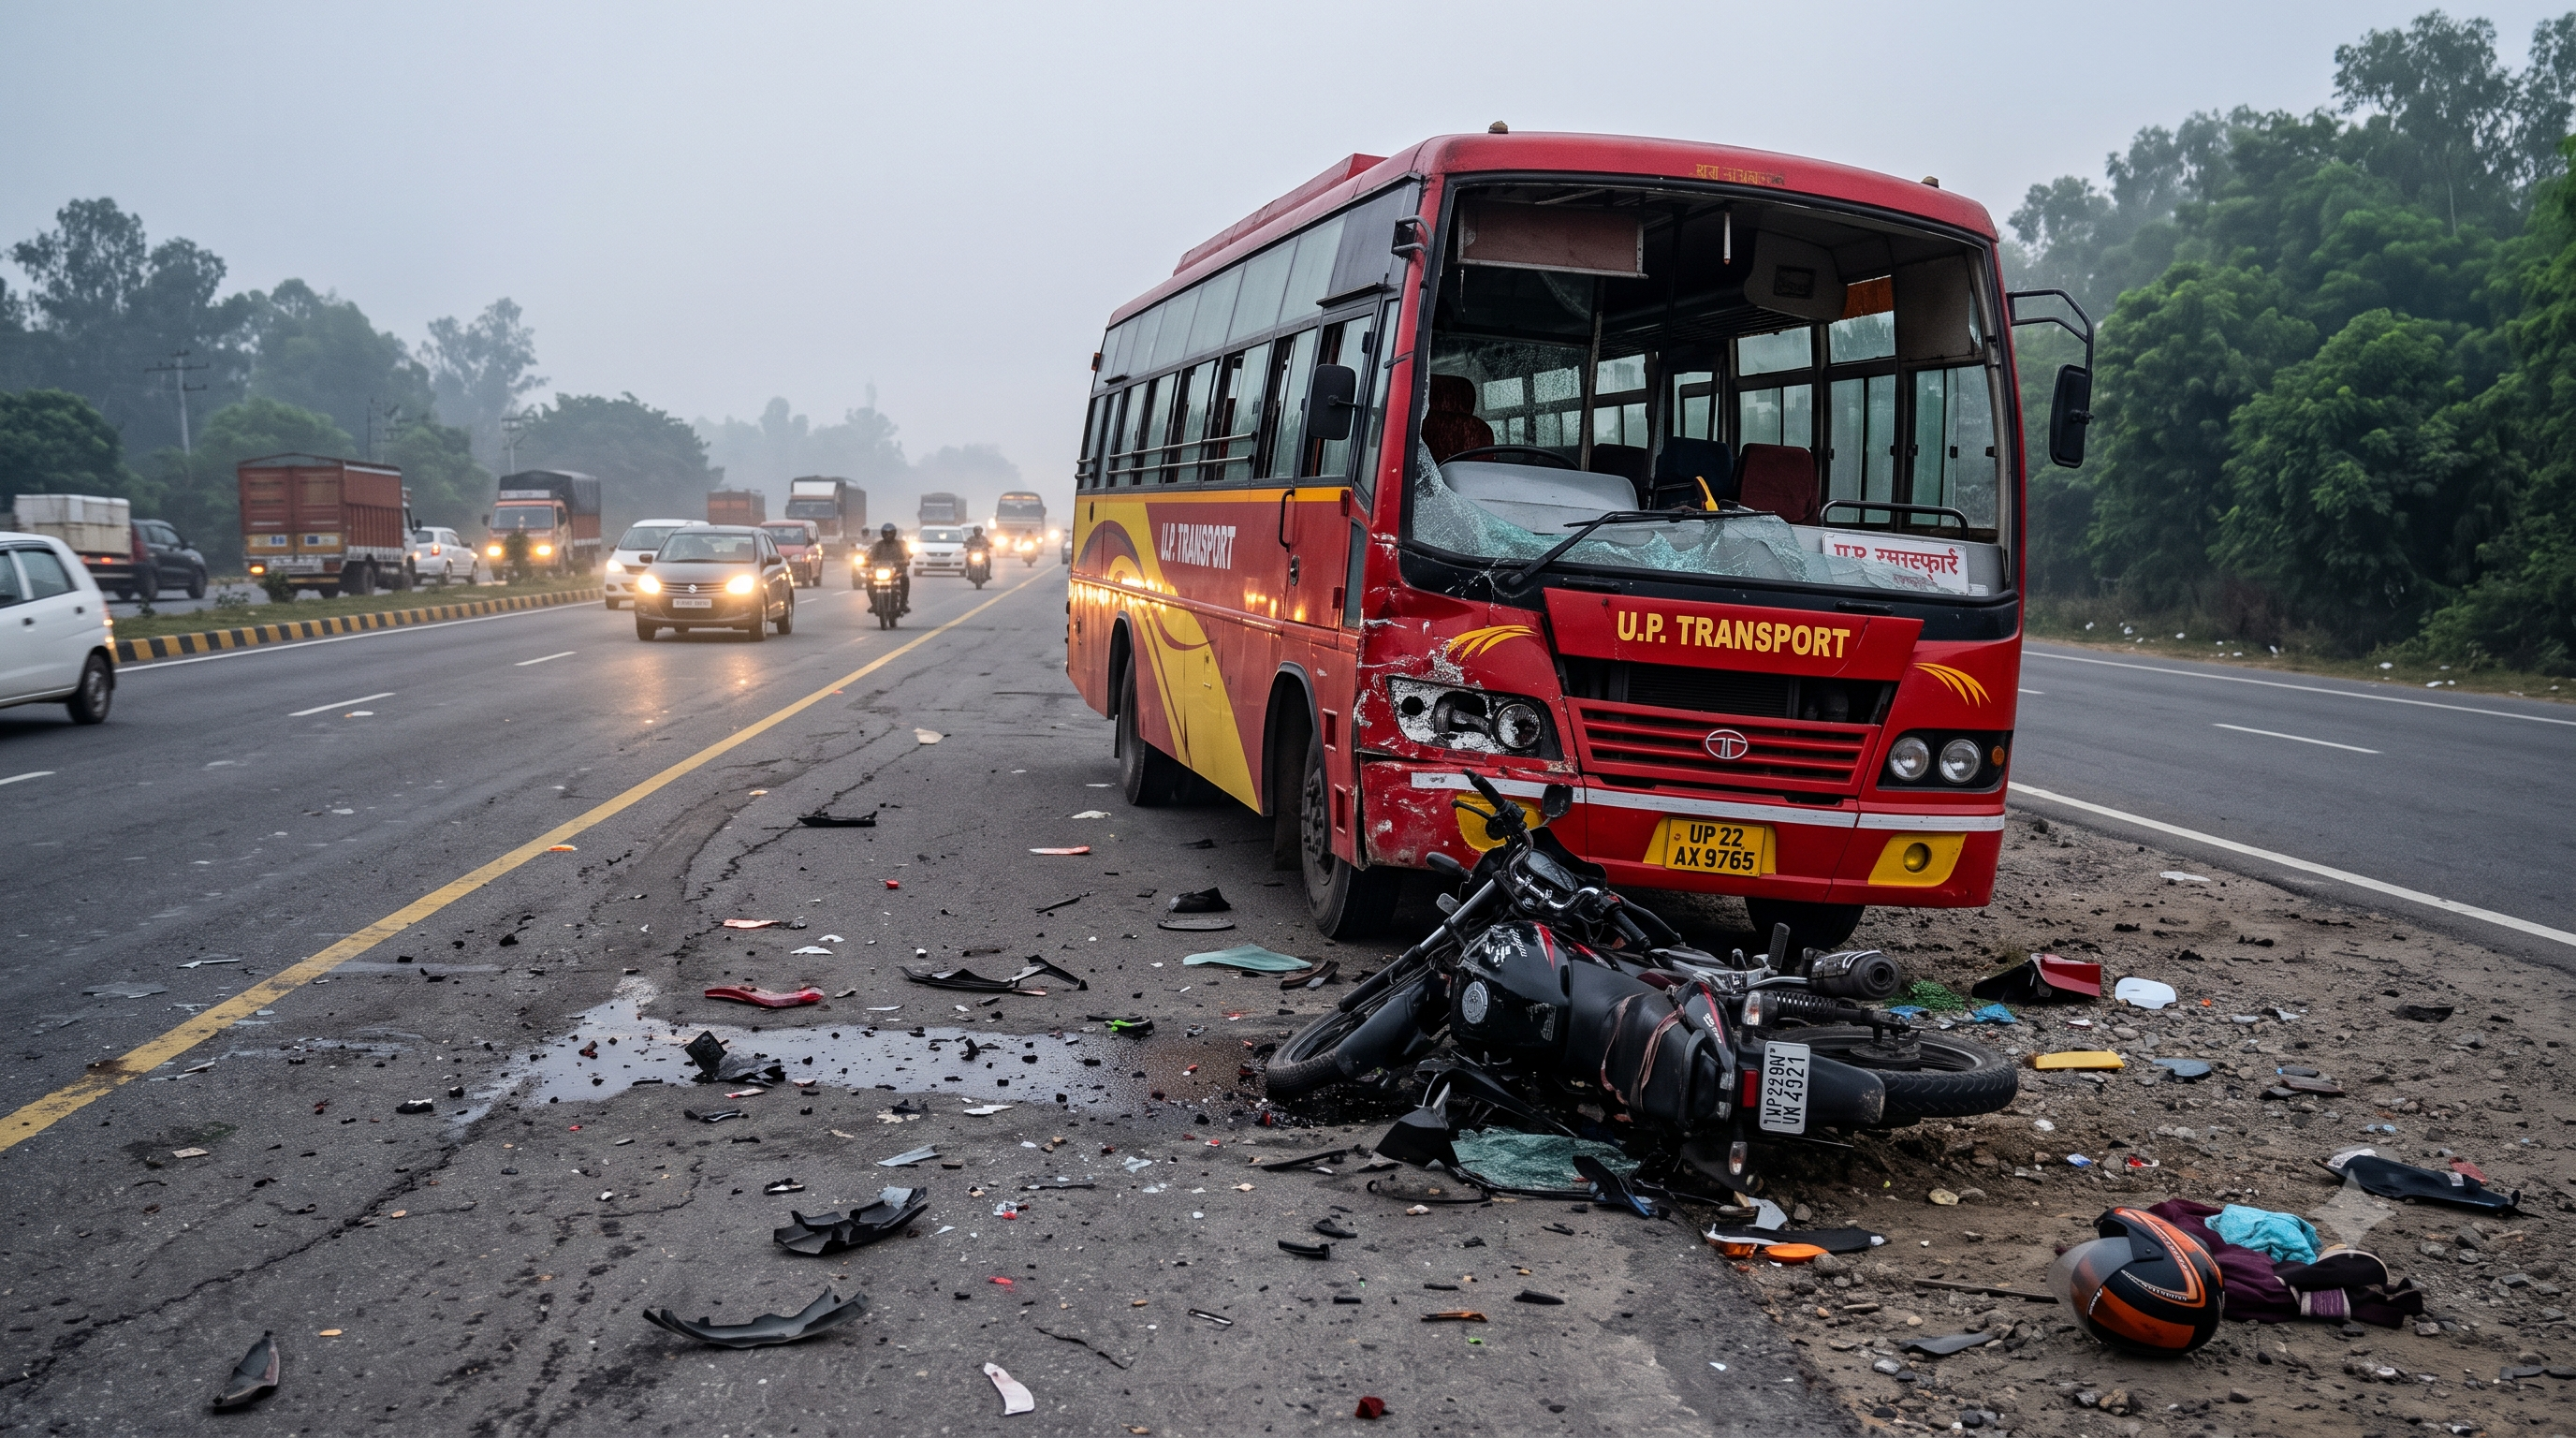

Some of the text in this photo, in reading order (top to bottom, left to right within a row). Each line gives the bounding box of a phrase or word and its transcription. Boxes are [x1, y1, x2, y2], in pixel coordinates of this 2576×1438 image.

[1161, 522, 1237, 569] U.P. TRANSPORT
[1617, 610, 1851, 658] U.P. TRANSPORT
[1690, 824, 1744, 847] UP 22
[1674, 846, 1755, 871] AX 9765
[1783, 1057, 1806, 1102] 4921
